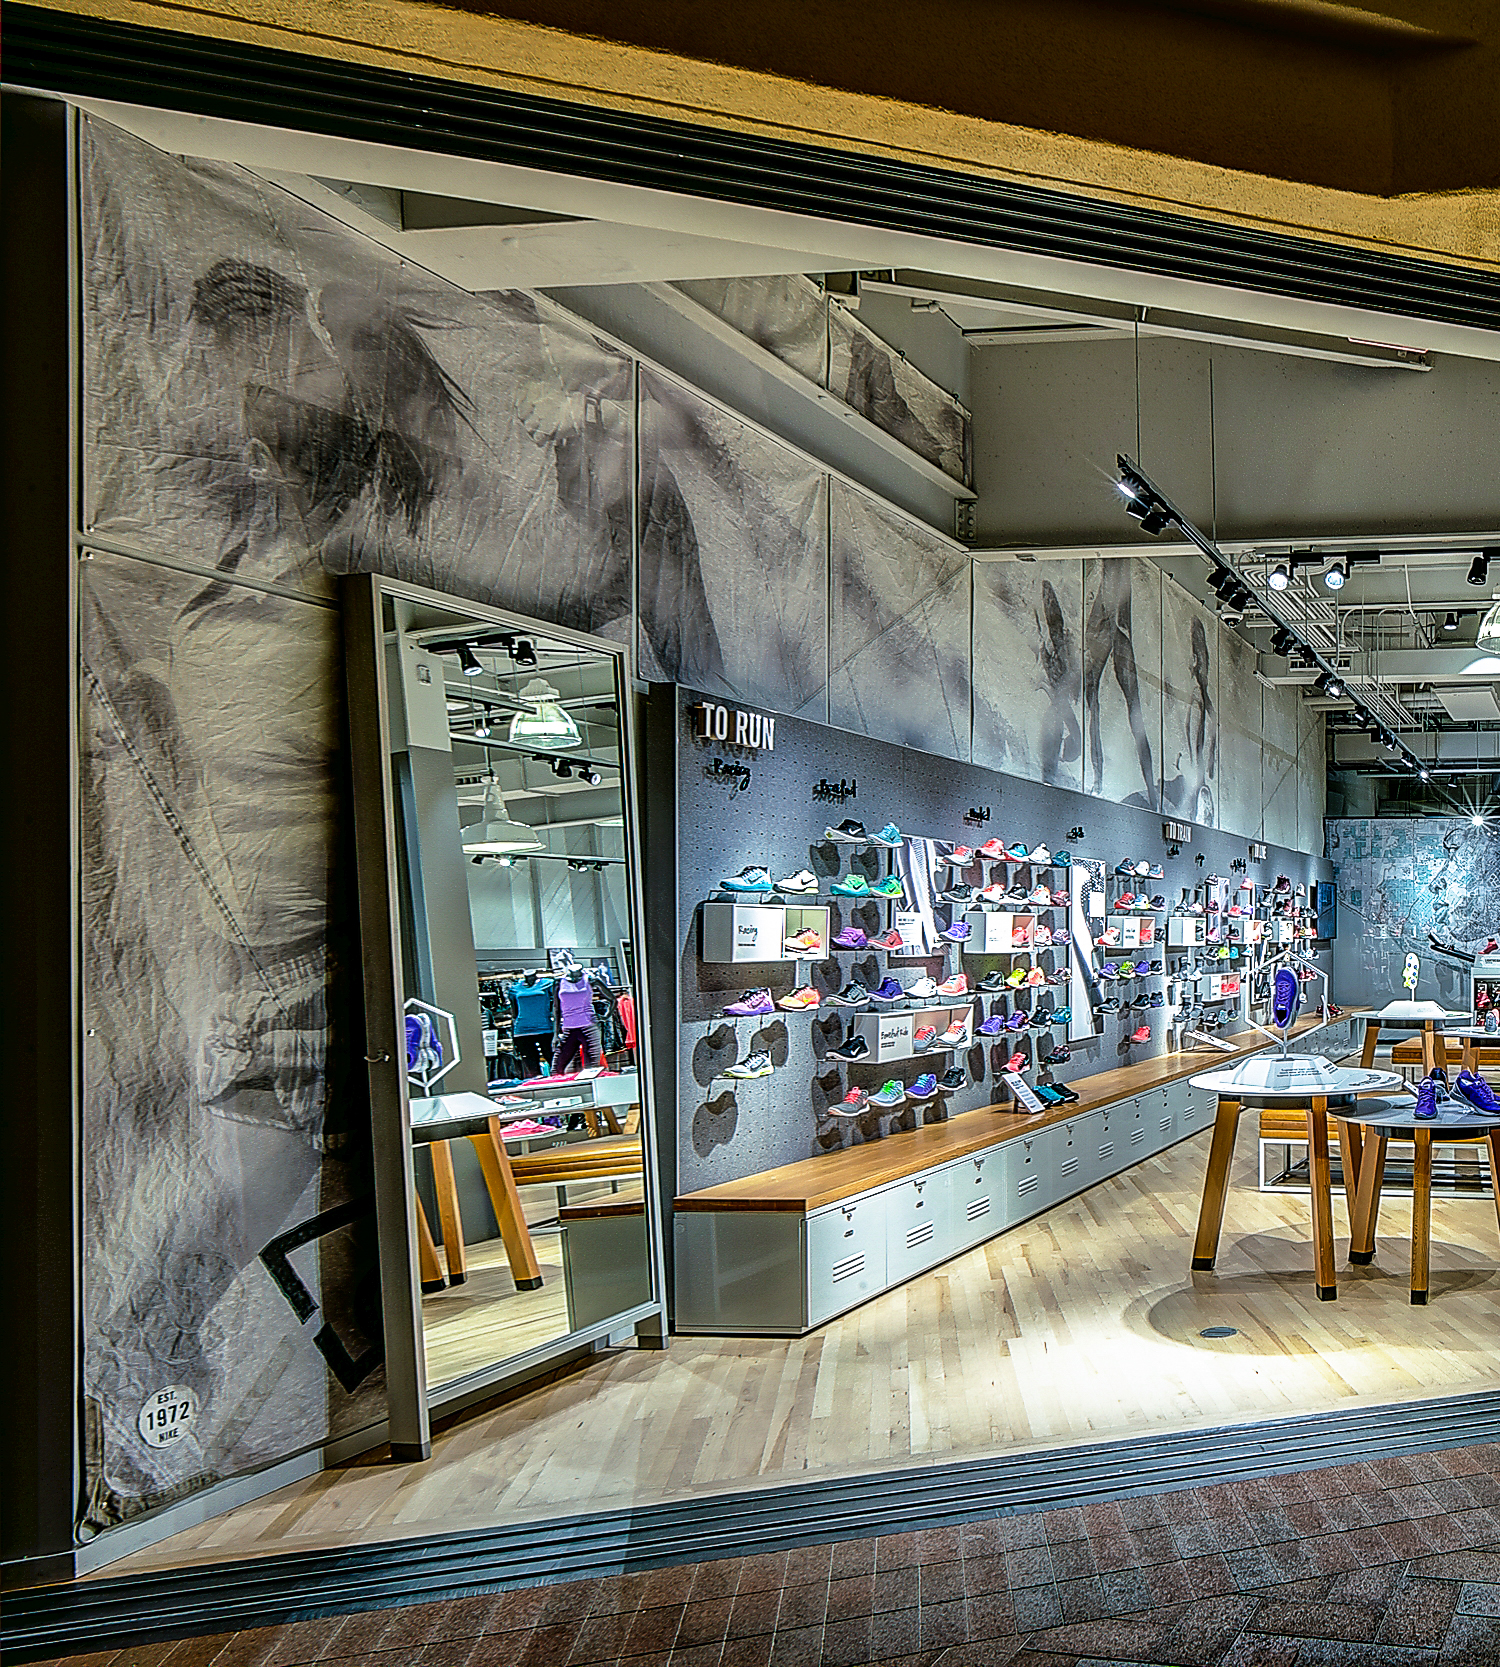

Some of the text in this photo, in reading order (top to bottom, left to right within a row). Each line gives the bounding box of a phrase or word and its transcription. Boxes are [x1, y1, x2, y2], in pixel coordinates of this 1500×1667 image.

[702, 701, 775, 751] TO RUN
[1177, 823, 1192, 843] TRAIN
[738, 924, 758, 942] Racing
[157, 1390, 177, 1404] EST.
[146, 1401, 190, 1431] 1972
[158, 1427, 179, 1443] NIKE
